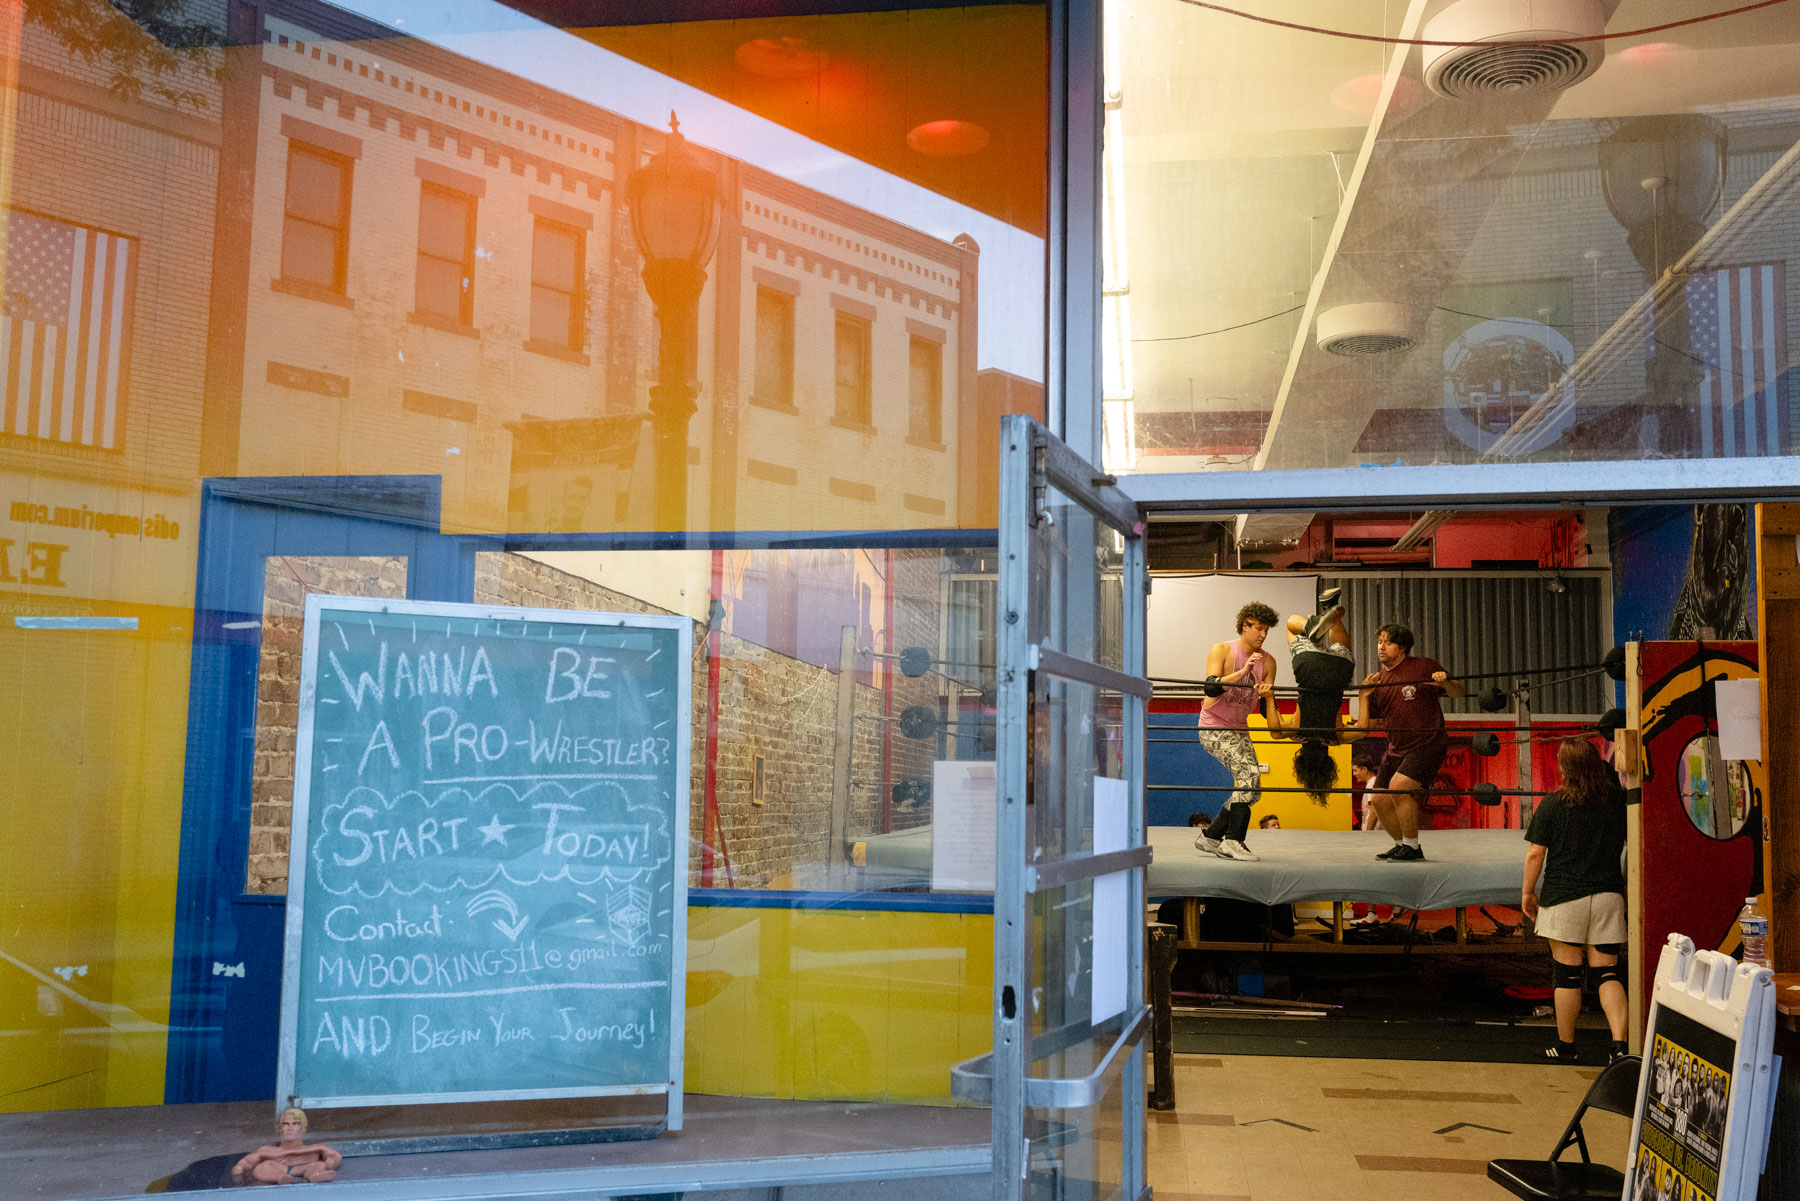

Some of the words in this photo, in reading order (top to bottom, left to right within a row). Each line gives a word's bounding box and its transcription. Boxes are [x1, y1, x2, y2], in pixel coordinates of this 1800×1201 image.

[329, 641, 498, 712] WANNA
[546, 646, 616, 703] BE
[357, 719, 400, 776] A
[422, 706, 671, 770] PRO-WRESTLER?
[332, 805, 468, 867] START
[318, 939, 662, 988] MVBOOKINGS11@gmail.com
[312, 1012, 391, 1058] AND
[551, 1006, 656, 1050] Journey!
